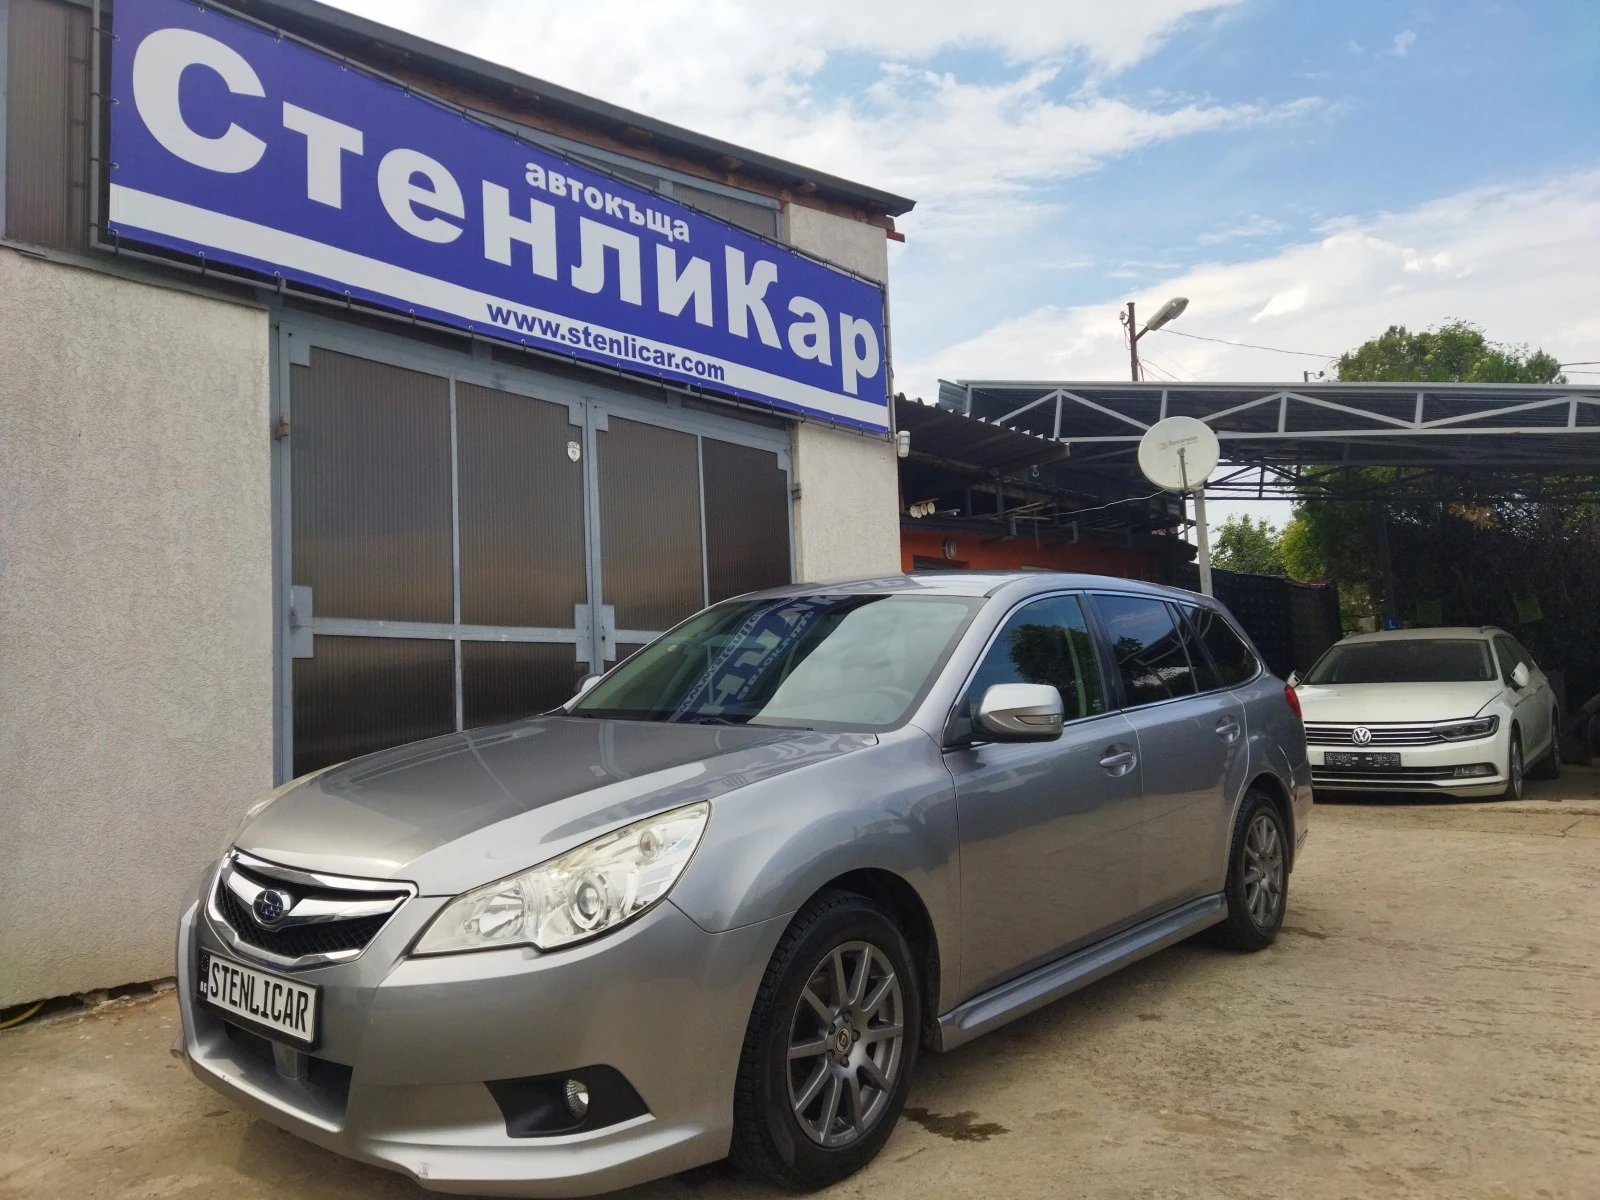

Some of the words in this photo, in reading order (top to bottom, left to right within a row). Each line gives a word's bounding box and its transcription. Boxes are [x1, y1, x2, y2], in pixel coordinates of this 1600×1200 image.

[132, 27, 880, 394] СтенлиКар
[525, 162, 690, 243] автокъща
[487, 303, 725, 382] www.stenlicar.com
[210, 962, 309, 1033] STENLICAR
